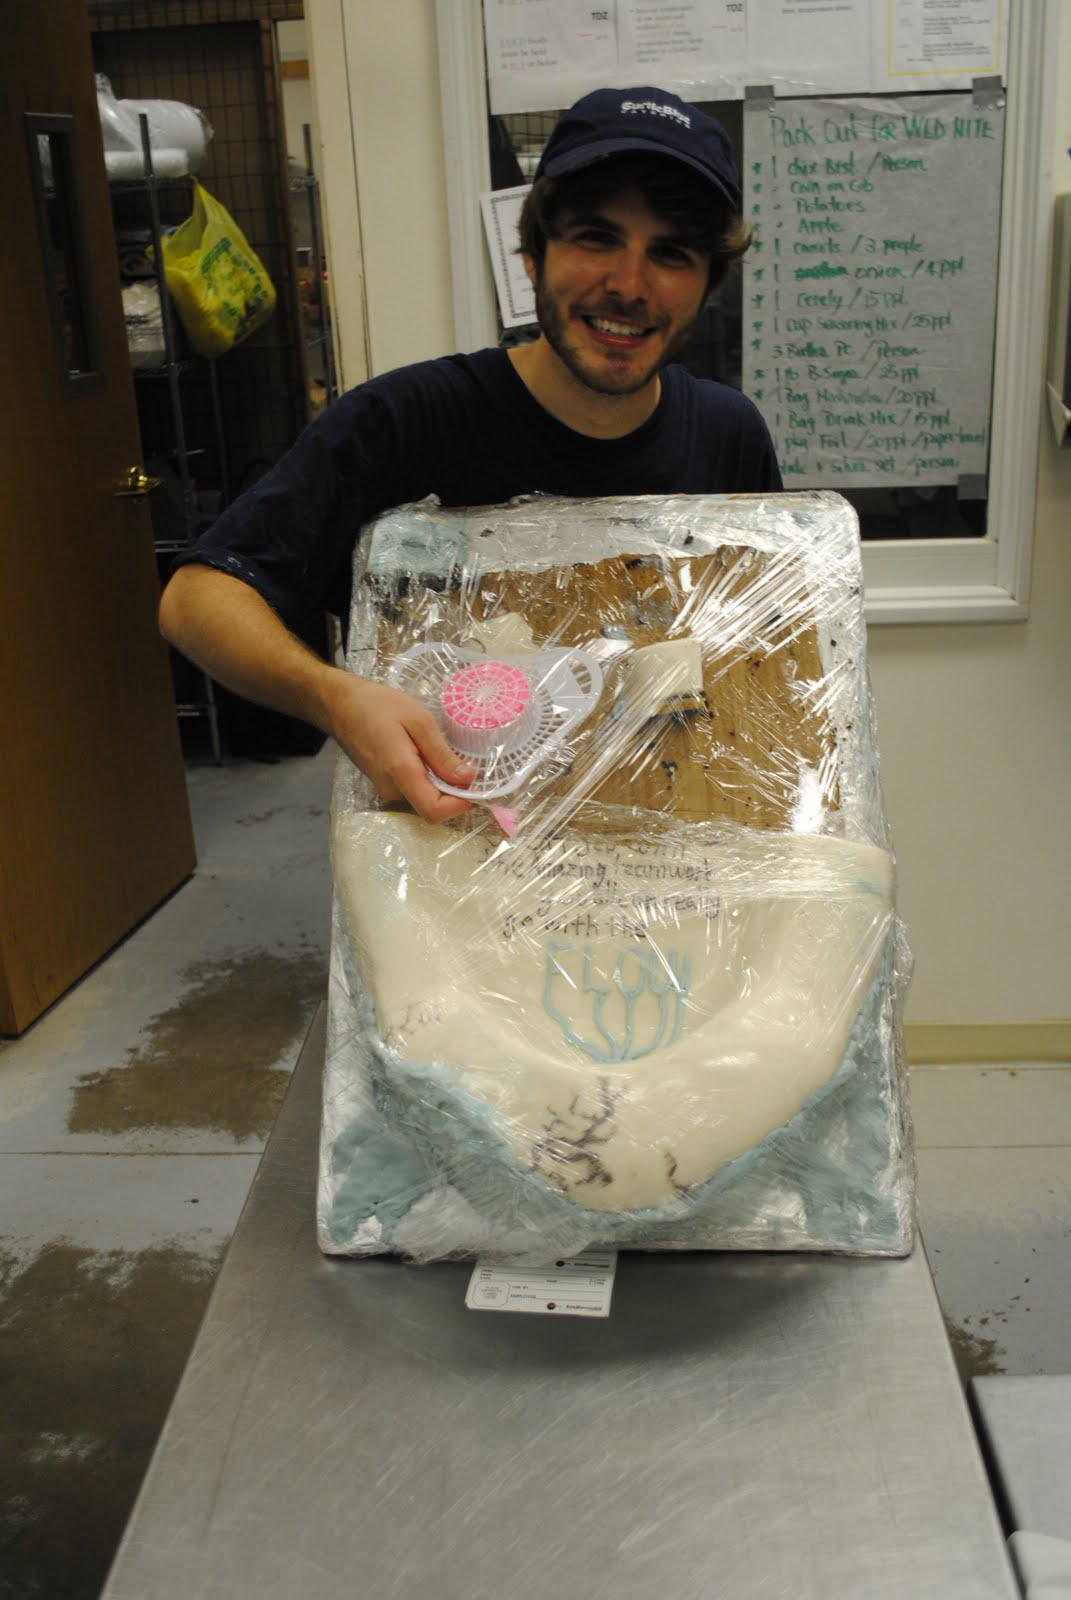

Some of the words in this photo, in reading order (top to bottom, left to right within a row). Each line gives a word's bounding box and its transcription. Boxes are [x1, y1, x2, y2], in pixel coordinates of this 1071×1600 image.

[768, 115, 816, 149] Pack
[823, 112, 859, 144] Out
[953, 115, 996, 140] NITE
[793, 195, 866, 214] Potatoes
[798, 215, 843, 234] Apple
[784, 386, 811, 412] Bag
[787, 409, 816, 436] Bag
